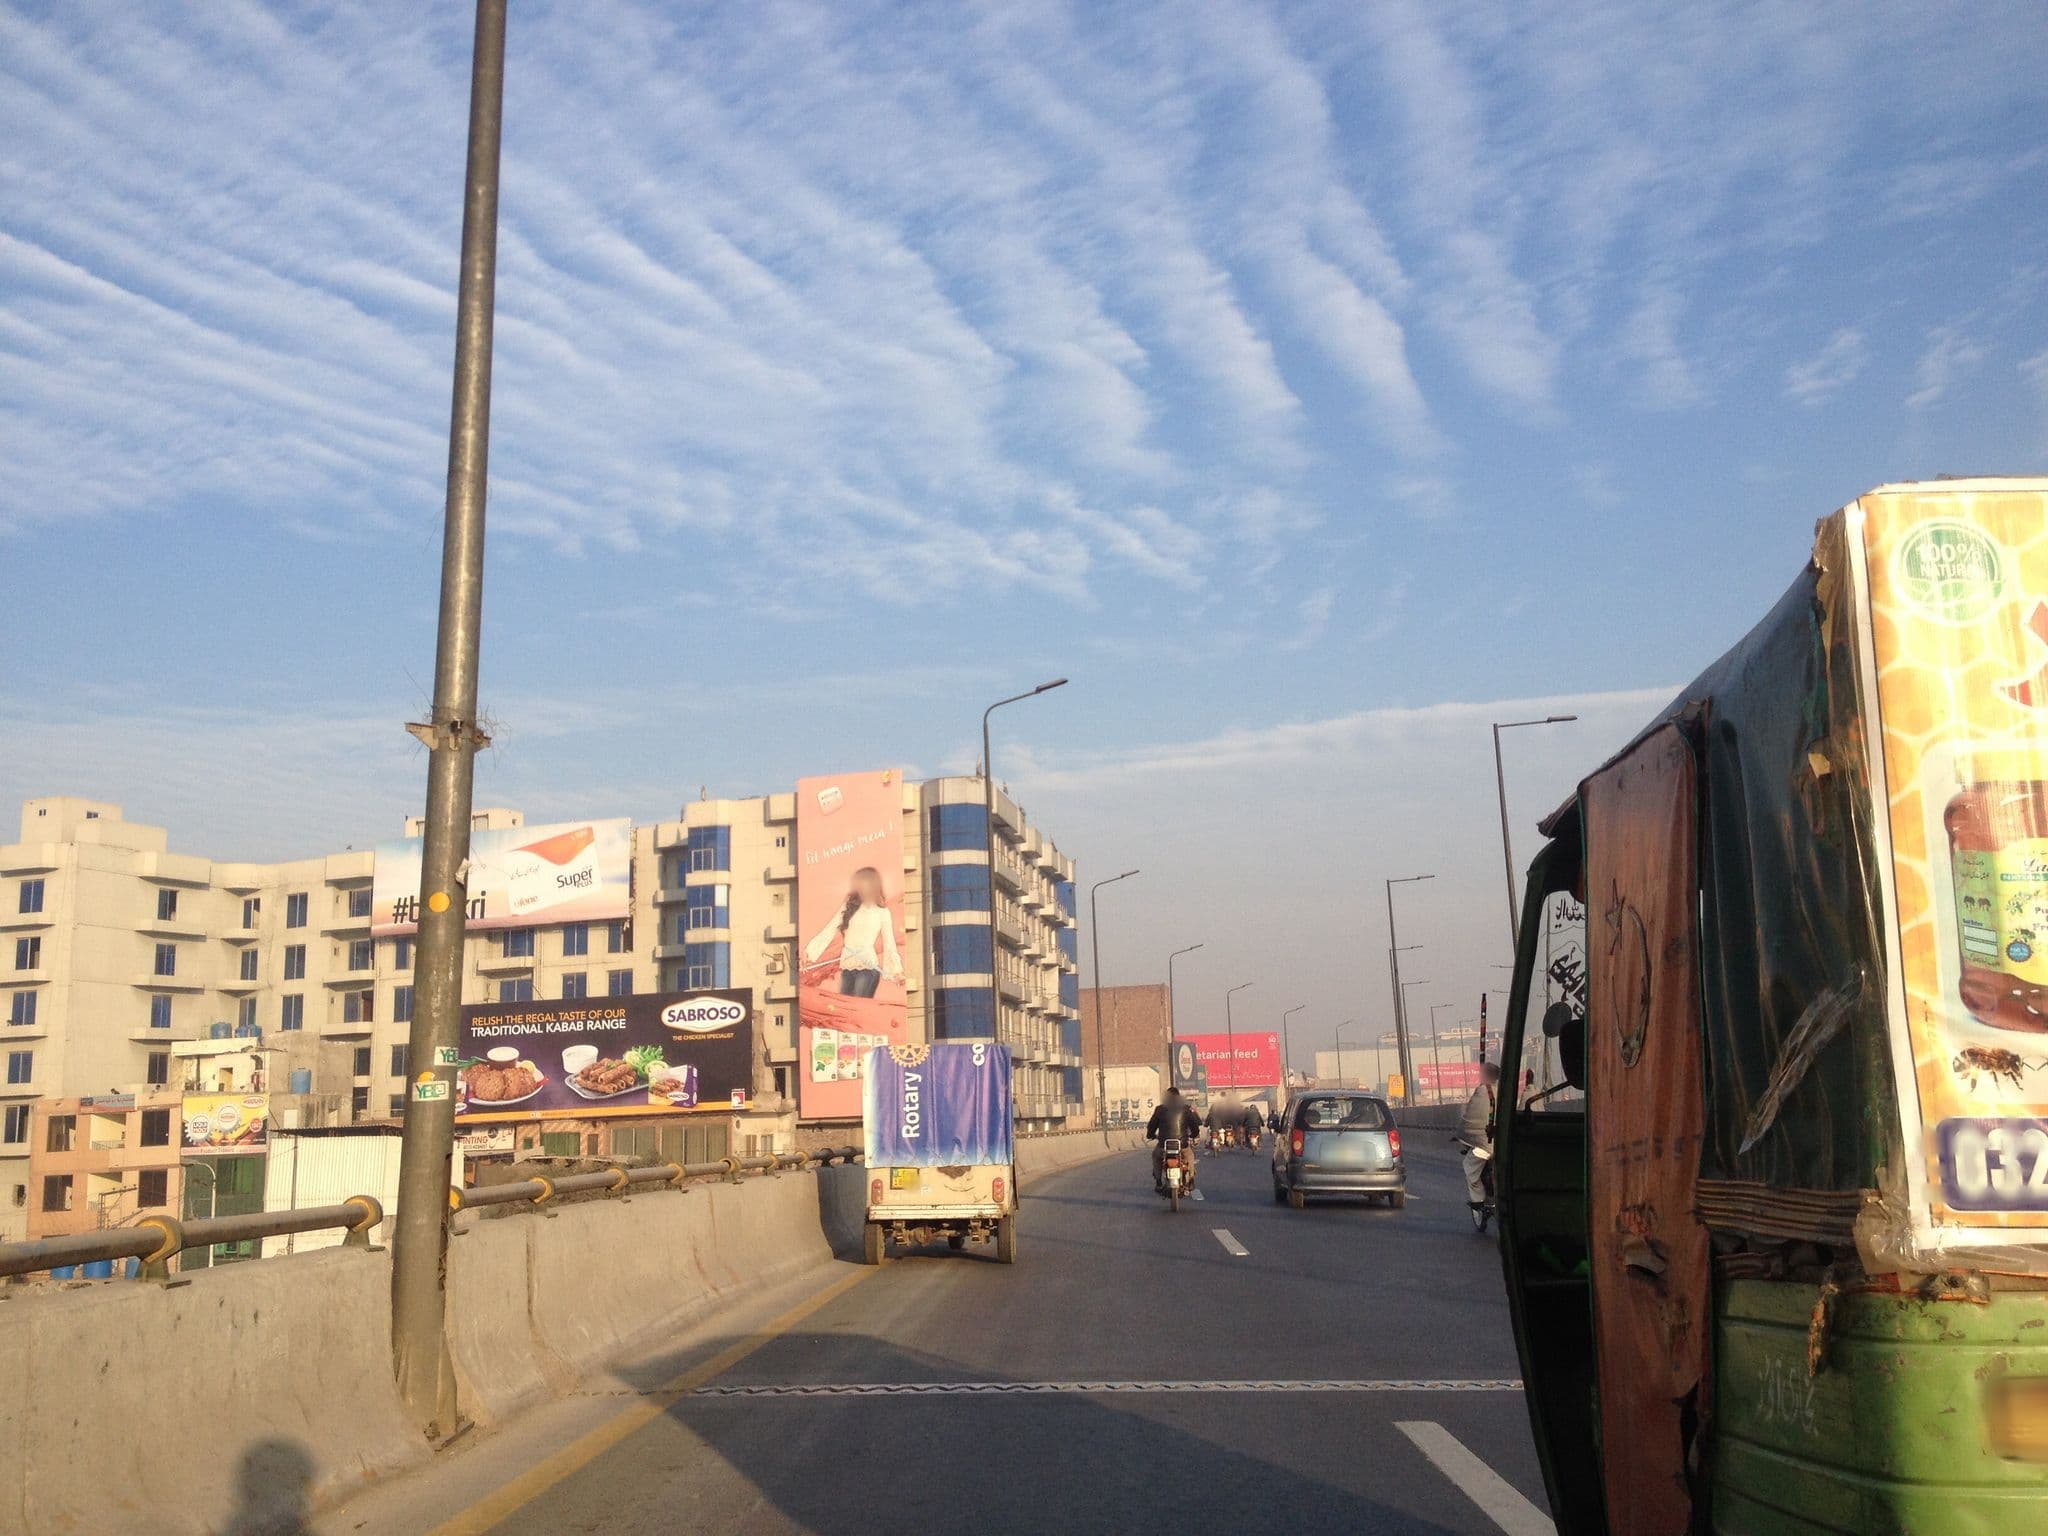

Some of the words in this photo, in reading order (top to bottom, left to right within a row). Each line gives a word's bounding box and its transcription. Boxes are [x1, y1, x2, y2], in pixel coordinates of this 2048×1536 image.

[556, 868, 593, 888] Super
[472, 1016, 502, 1027] RELISH
[505, 1014, 523, 1025] THE
[526, 1012, 557, 1023] REGAL
[559, 1011, 586, 1021] TASTE
[588, 1009, 602, 1020] OF
[604, 1008, 625, 1019] OUR
[667, 1006, 741, 1023] SABROSO
[471, 1023, 543, 1038] TRADITIONAL
[546, 1020, 584, 1033] KABAB
[587, 1018, 627, 1031] RANGE
[1233, 1048, 1258, 1059] feed
[902, 1072, 922, 1138] Rotary
